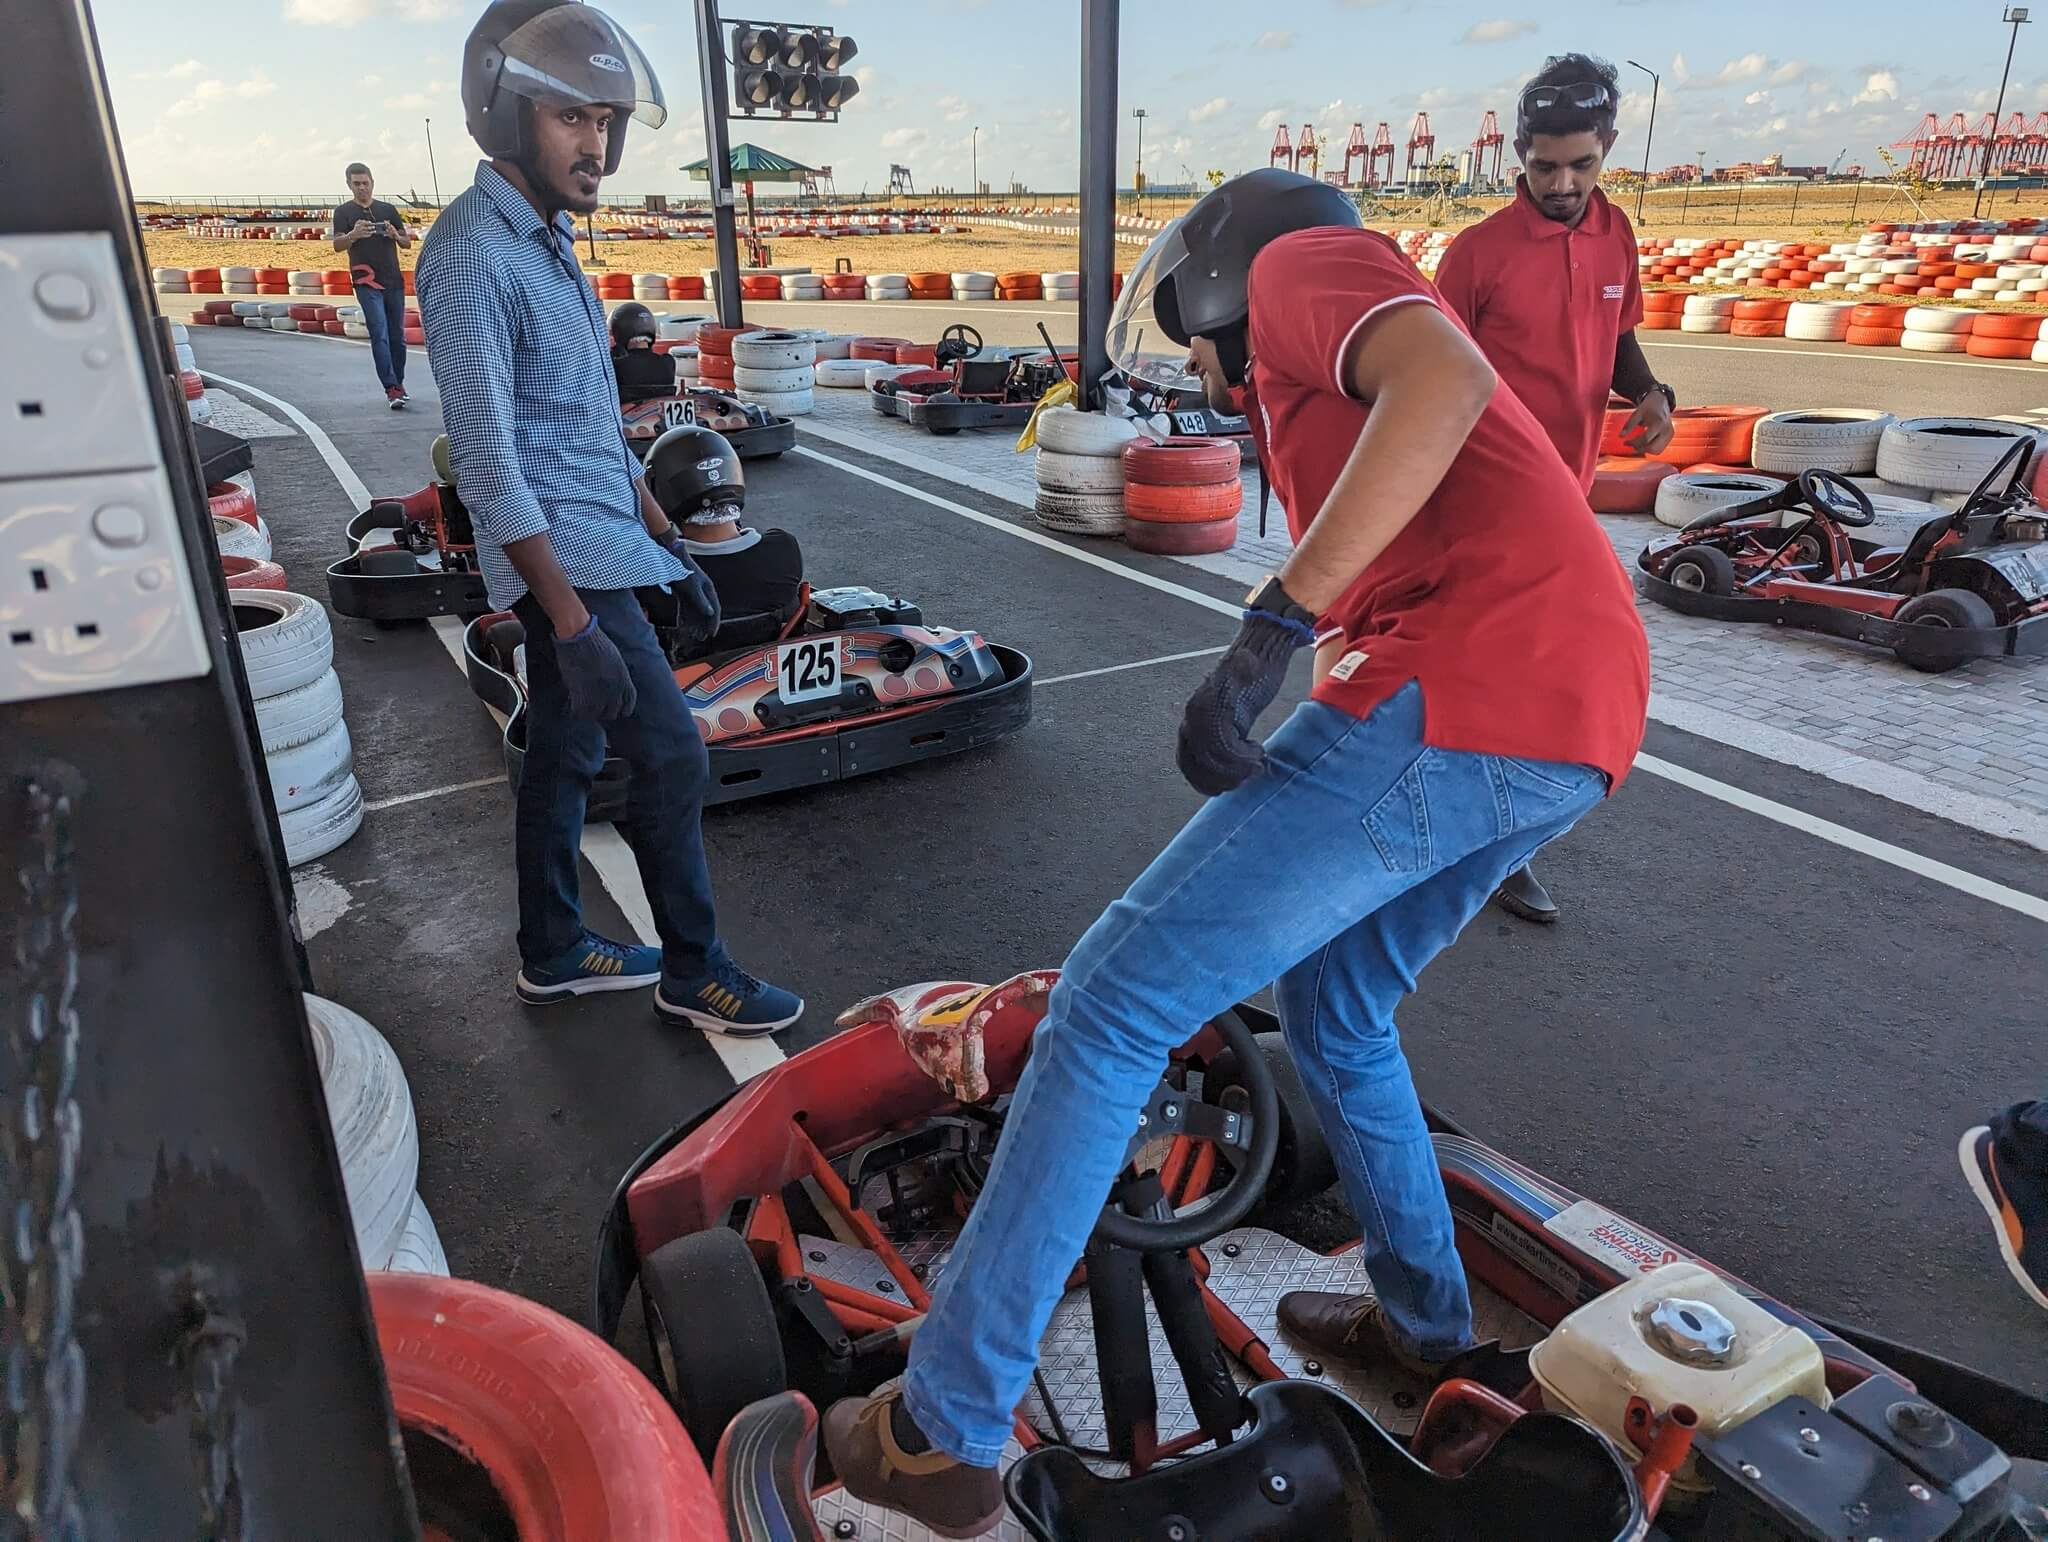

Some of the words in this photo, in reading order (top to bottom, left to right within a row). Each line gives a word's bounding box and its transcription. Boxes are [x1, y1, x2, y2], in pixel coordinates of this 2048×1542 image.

[666, 401, 694, 426] 126
[1179, 415, 1206, 433] 148
[781, 641, 836, 696] 125
[1588, 1231, 1622, 1252] LANKA
[1601, 1224, 1662, 1257] CIRCUIT
[1621, 1252, 1641, 1264] SRI
